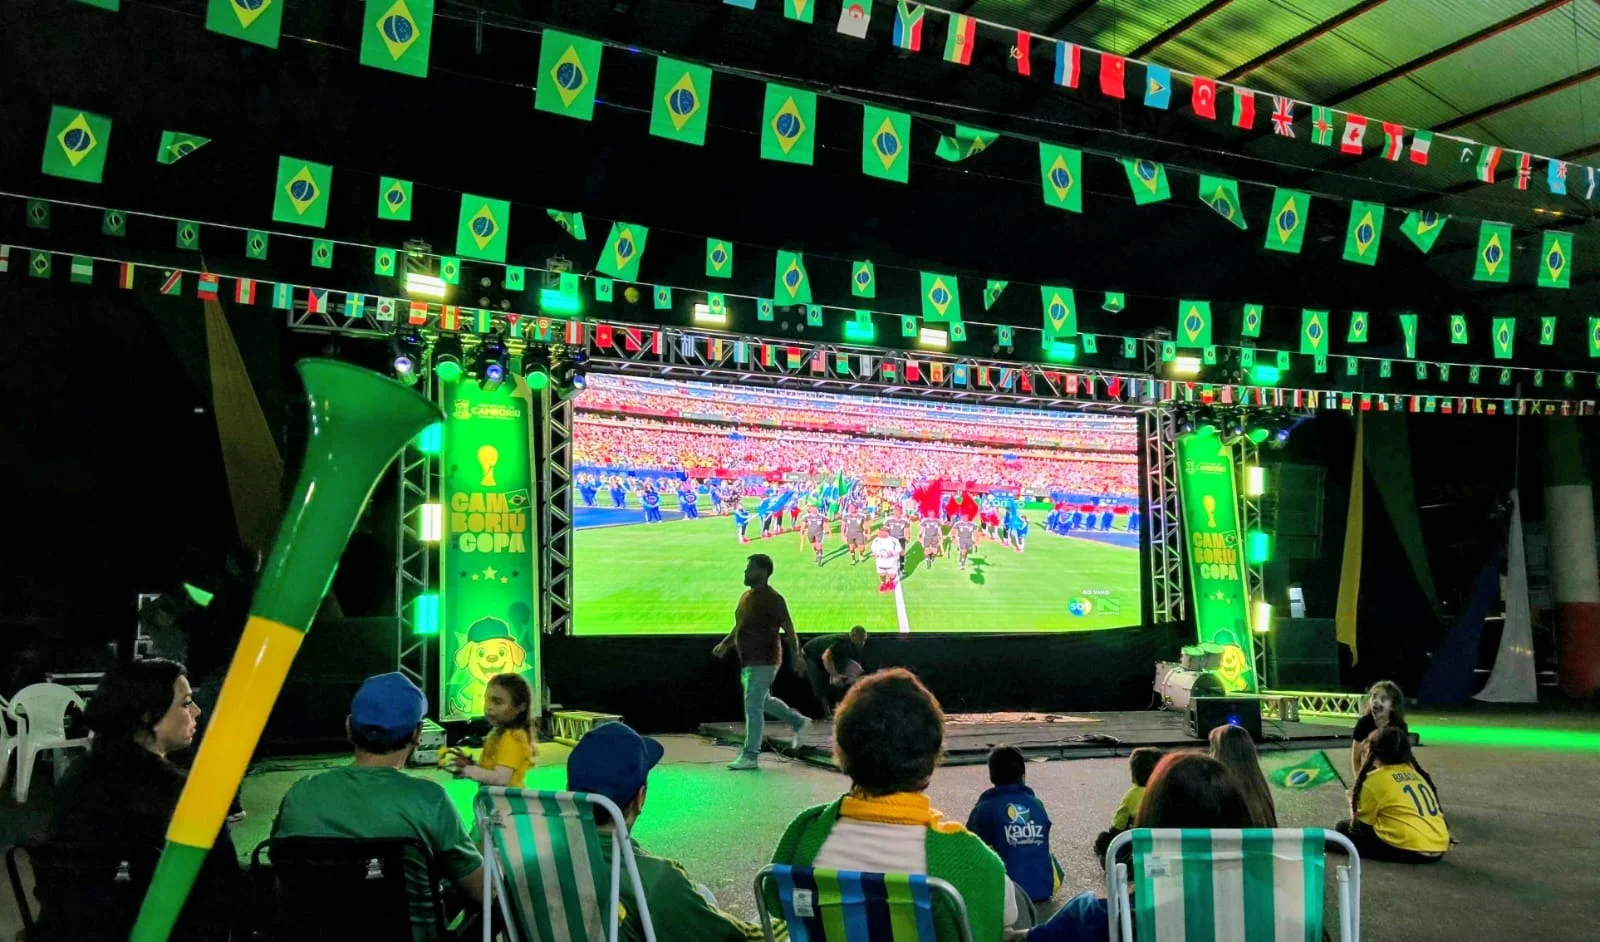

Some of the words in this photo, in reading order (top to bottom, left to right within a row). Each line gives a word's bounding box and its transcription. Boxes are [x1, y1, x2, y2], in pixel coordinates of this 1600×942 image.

[451, 492, 508, 512] CAM
[459, 532, 526, 553] COPA
[1193, 532, 1226, 548] CAM
[1200, 564, 1238, 580] COPA
[1403, 783, 1438, 816] 10
